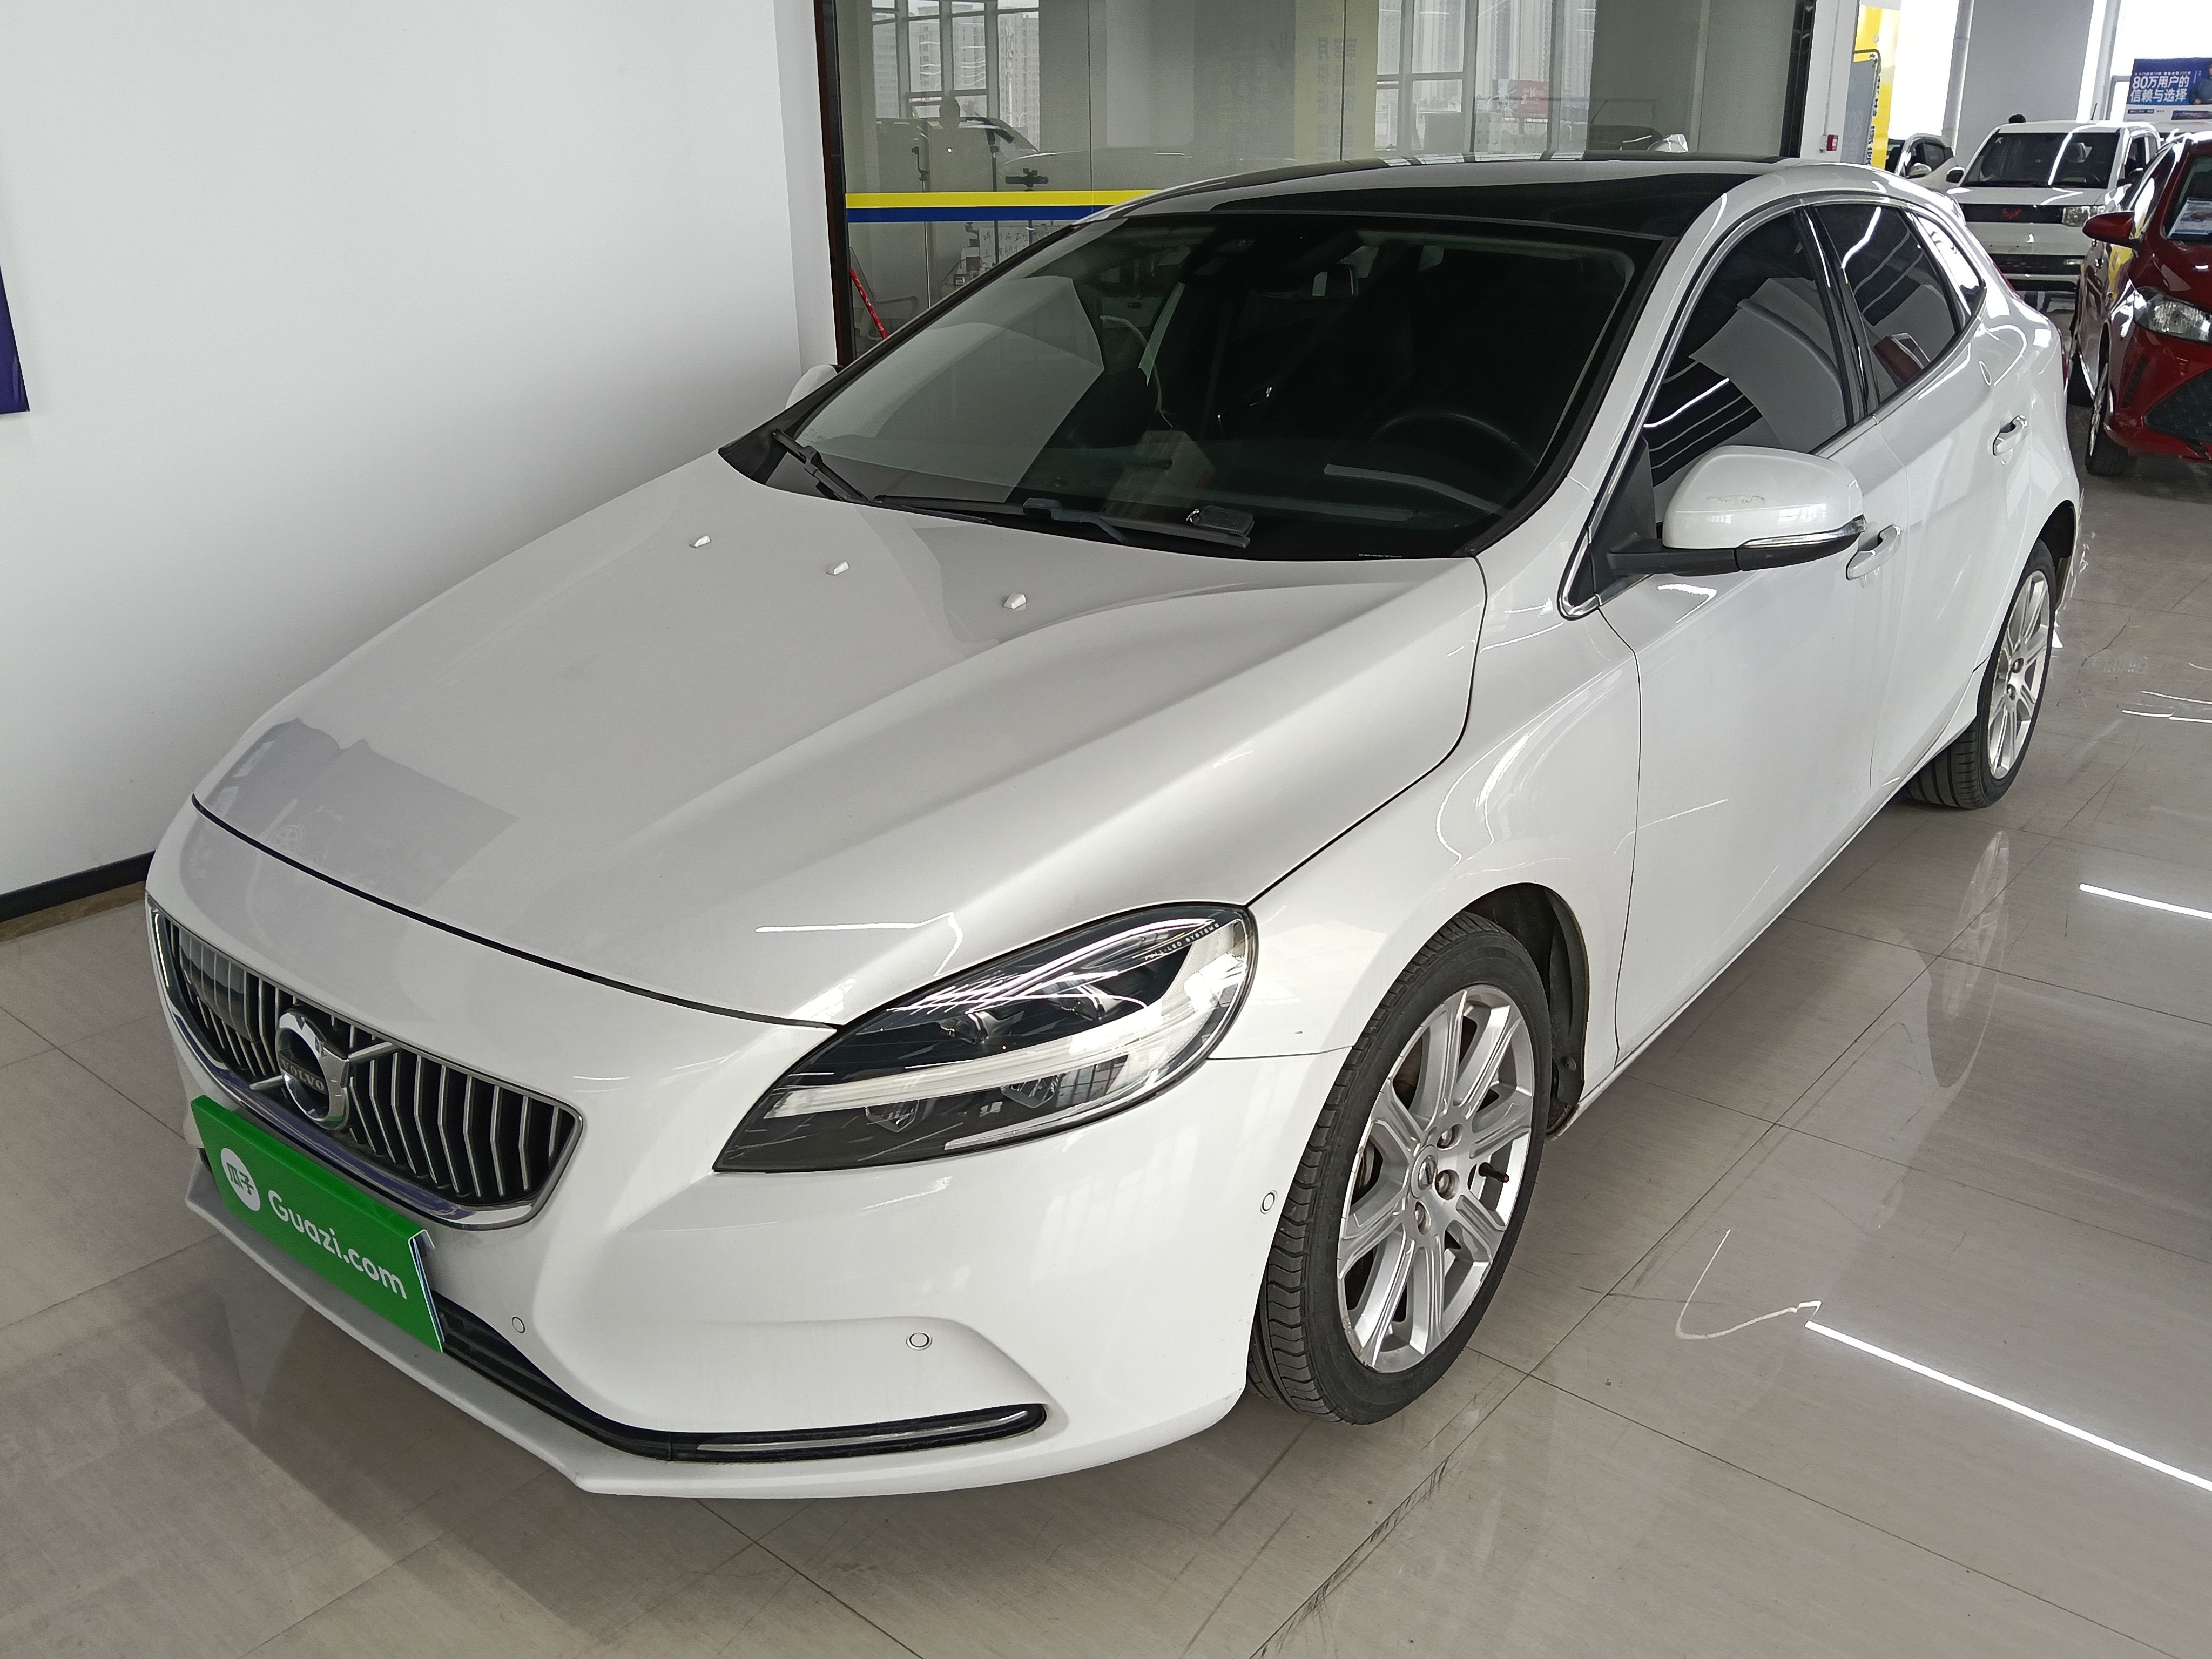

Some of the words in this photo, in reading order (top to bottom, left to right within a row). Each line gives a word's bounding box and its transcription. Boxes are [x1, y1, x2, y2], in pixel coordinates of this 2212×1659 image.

[2132, 75, 2190, 89] 80万用户的
[2130, 88, 2187, 103] 信赖与选择
[1185, 923, 1219, 942] SYSTEMS
[281, 1058, 325, 1090] VOLVO
[227, 1162, 253, 1195] 瓜子
[268, 1190, 407, 1299] Guazi.com
